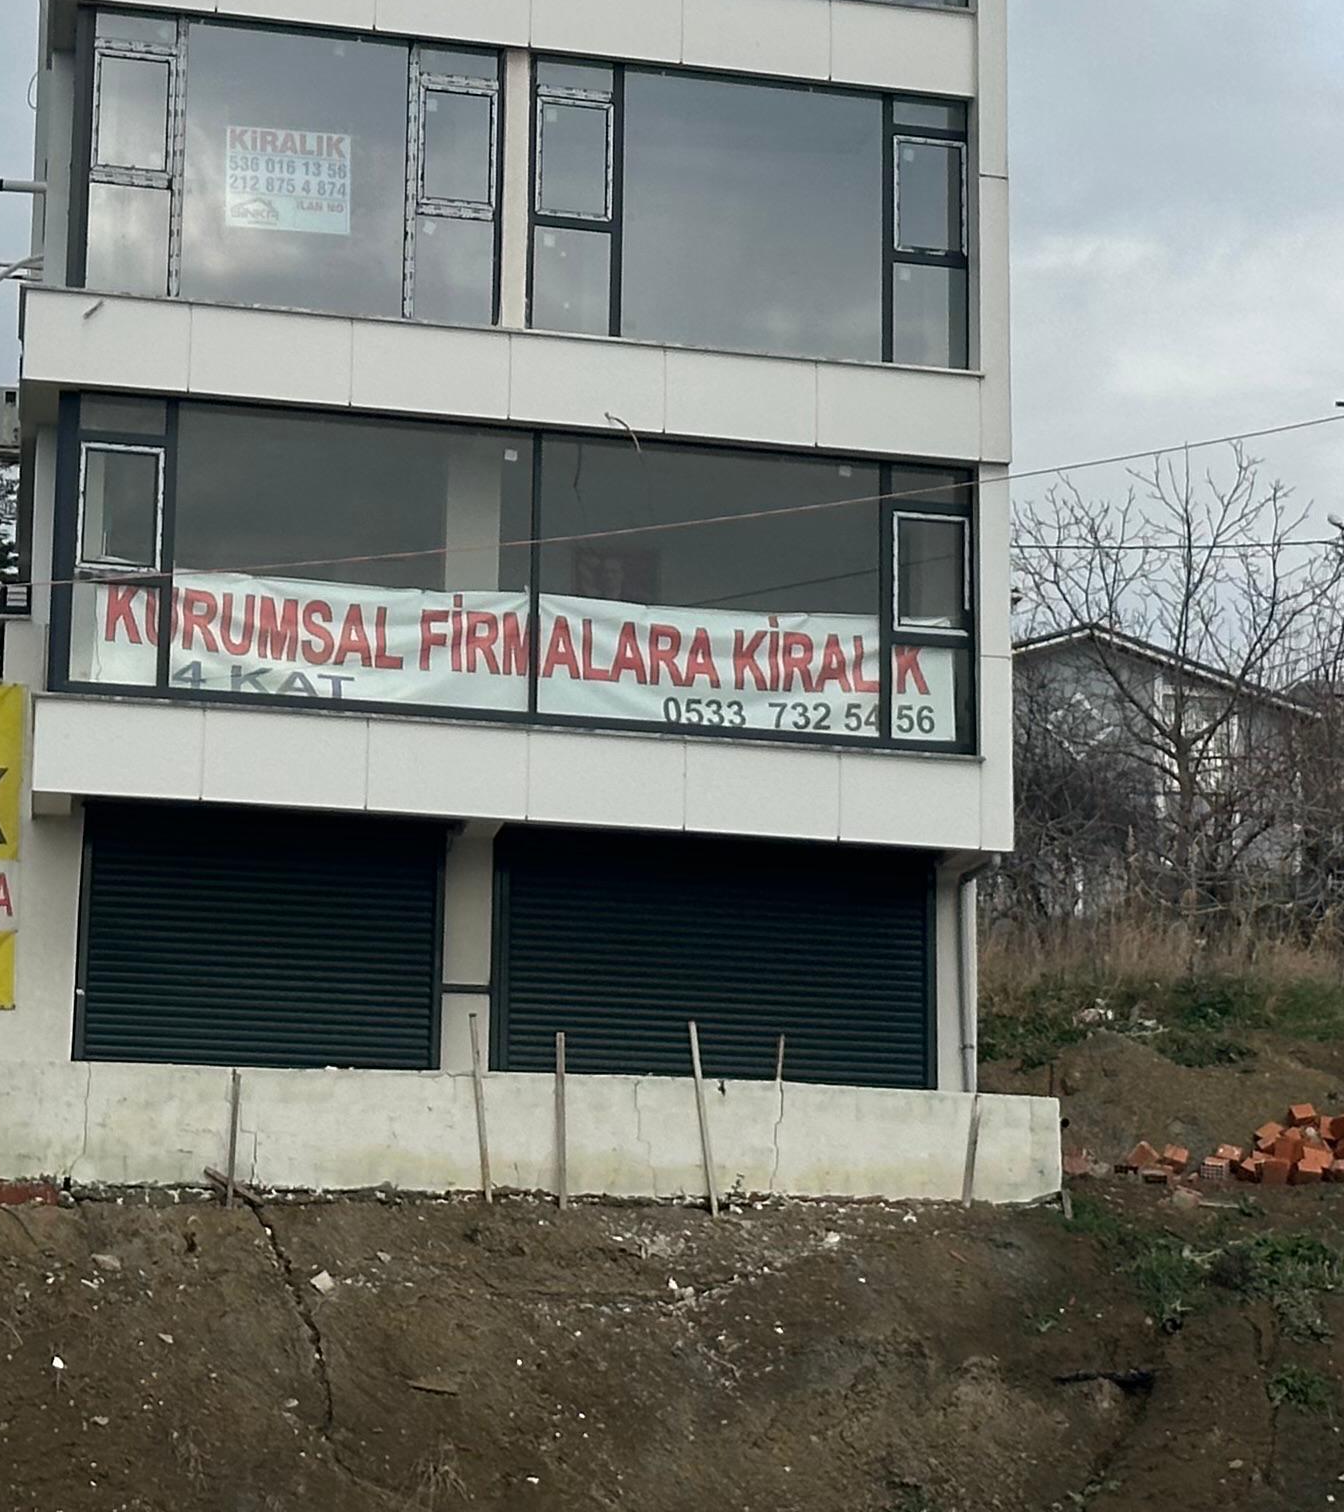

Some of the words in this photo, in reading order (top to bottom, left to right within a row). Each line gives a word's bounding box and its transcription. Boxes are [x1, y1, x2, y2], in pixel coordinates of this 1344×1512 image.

[229, 155, 260, 173] 536
[265, 158, 296, 176] 016
[302, 161, 322, 177] 13
[327, 163, 347, 180] 56
[229, 174, 260, 191] 212
[265, 177, 296, 194] 875
[301, 180, 312, 195] 4
[317, 181, 346, 198] 874
[104, 583, 404, 671] KURUMSAL
[418, 593, 720, 689] FİRMALARA
[732, 615, 931, 696] KİRALK
[172, 660, 206, 689] 4
[230, 664, 356, 699] KAT
[662, 696, 747, 728] 0533
[767, 700, 832, 732] 732
[844, 701, 880, 732] 54
[896, 705, 936, 735] 56
